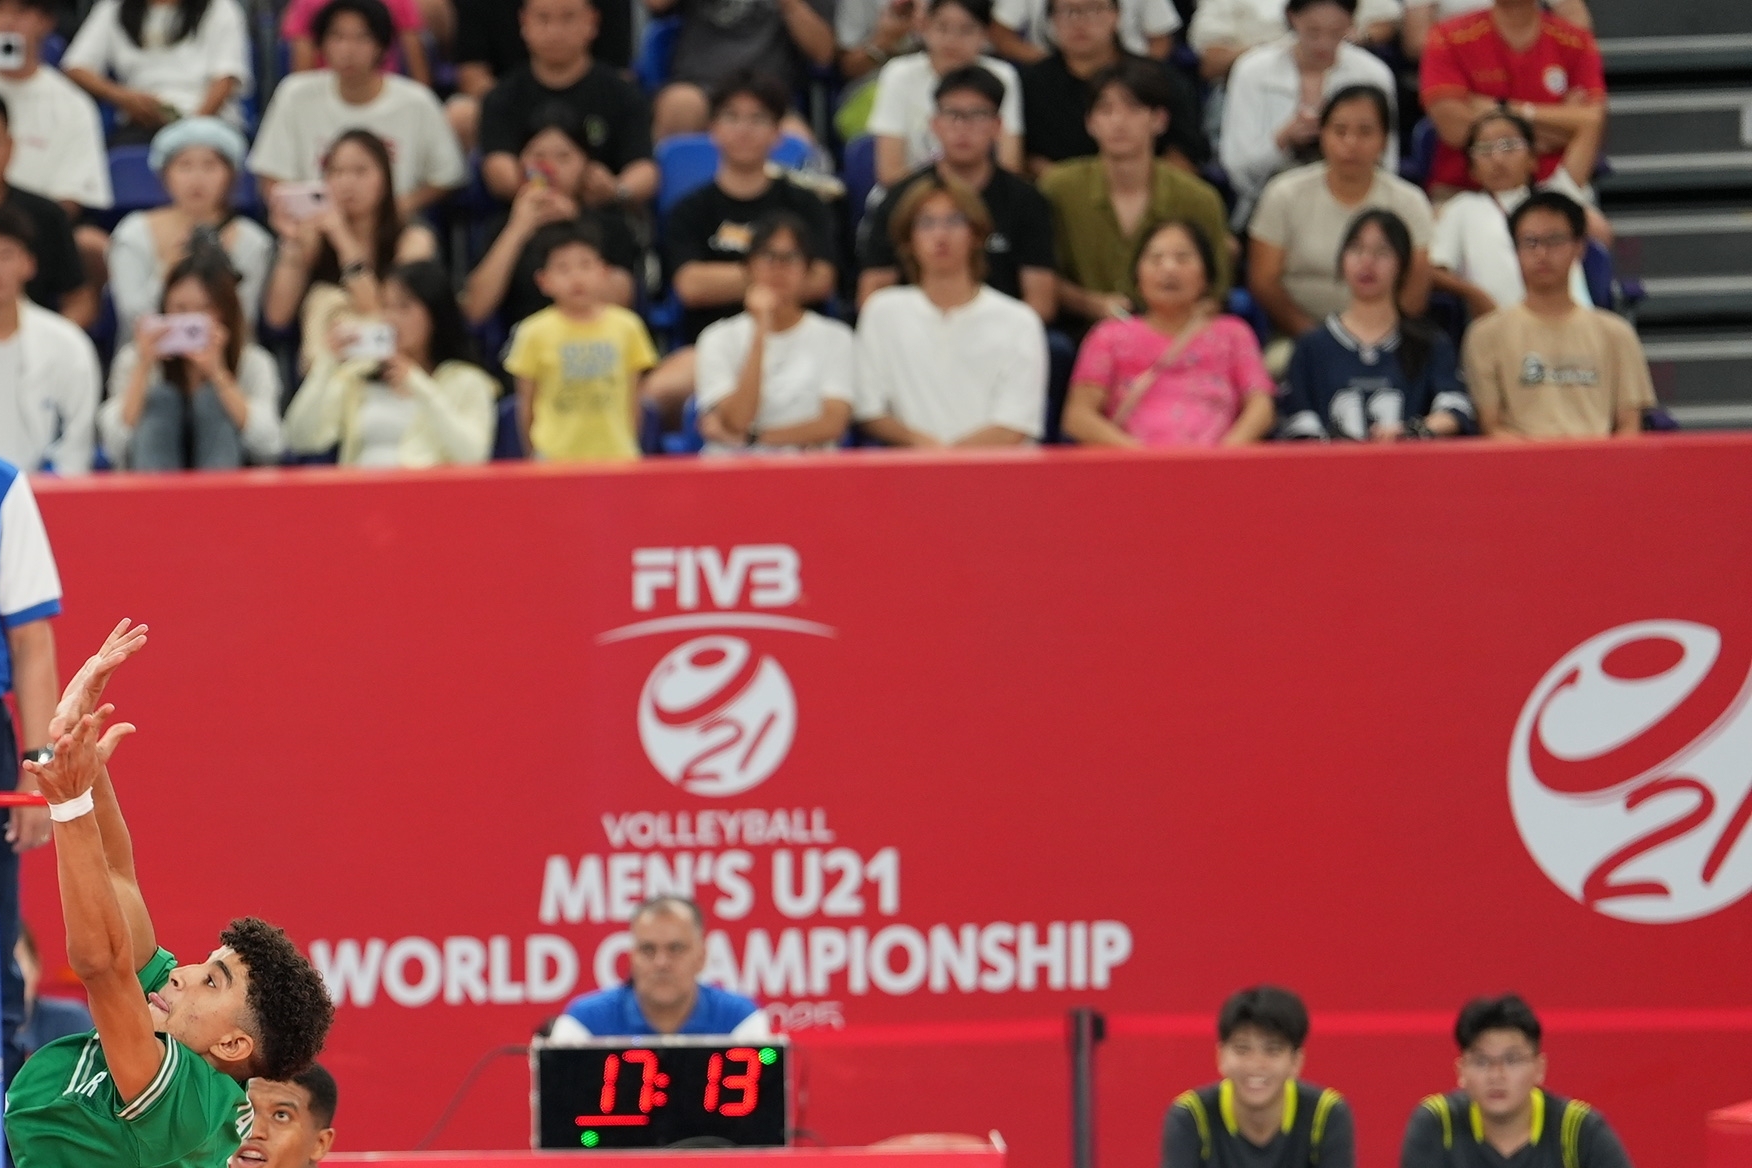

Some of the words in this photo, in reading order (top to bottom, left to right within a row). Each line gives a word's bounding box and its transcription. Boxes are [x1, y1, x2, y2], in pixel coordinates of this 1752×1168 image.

[632, 544, 801, 611] FIVB
[601, 808, 834, 849] VOLLEYBALL
[771, 846, 900, 918] U21
[310, 934, 579, 1008] WORLD
[594, 919, 1134, 998] CAMPIONSHIP
[704, 1047, 762, 1117] 13
